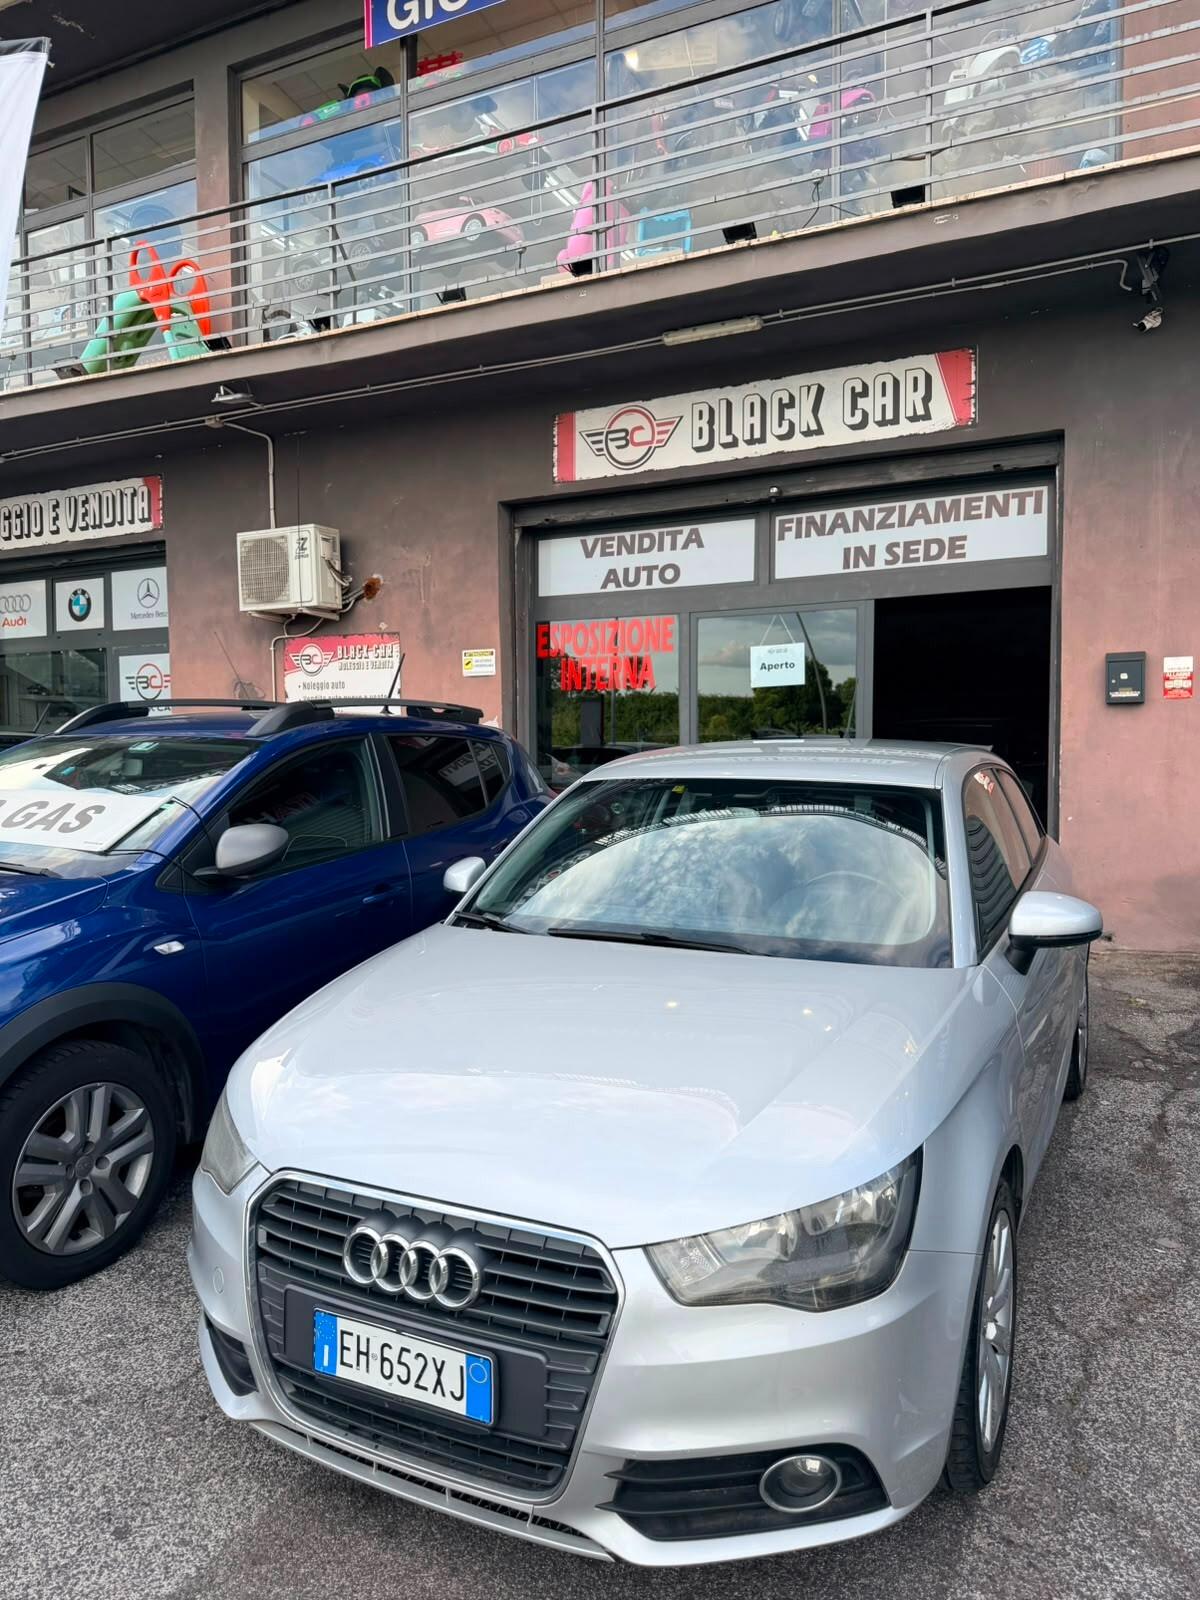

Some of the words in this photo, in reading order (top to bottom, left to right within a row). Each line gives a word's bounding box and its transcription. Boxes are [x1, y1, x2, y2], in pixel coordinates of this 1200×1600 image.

[691, 383, 824, 453] BLACK
[842, 367, 933, 430] CAR
[48, 499, 60, 535] E
[65, 485, 151, 532] VENDITA
[777, 490, 1044, 541] FINANZIAMENTI
[580, 527, 705, 559] VENDITA
[842, 544, 876, 570] IN
[884, 535, 968, 566] SEDE
[600, 563, 681, 590] AUTO
[2, 616, 27, 628] Audi
[537, 615, 675, 660] ESPOSIZIONE
[337, 645, 369, 660] BLACK
[374, 643, 394, 659] CAR
[760, 661, 795, 672] Aperto
[303, 681, 330, 691] Noleggio
[331, 681, 345, 690] auto
[560, 655, 656, 692] INTERNA
[1, 800, 105, 834] GAS
